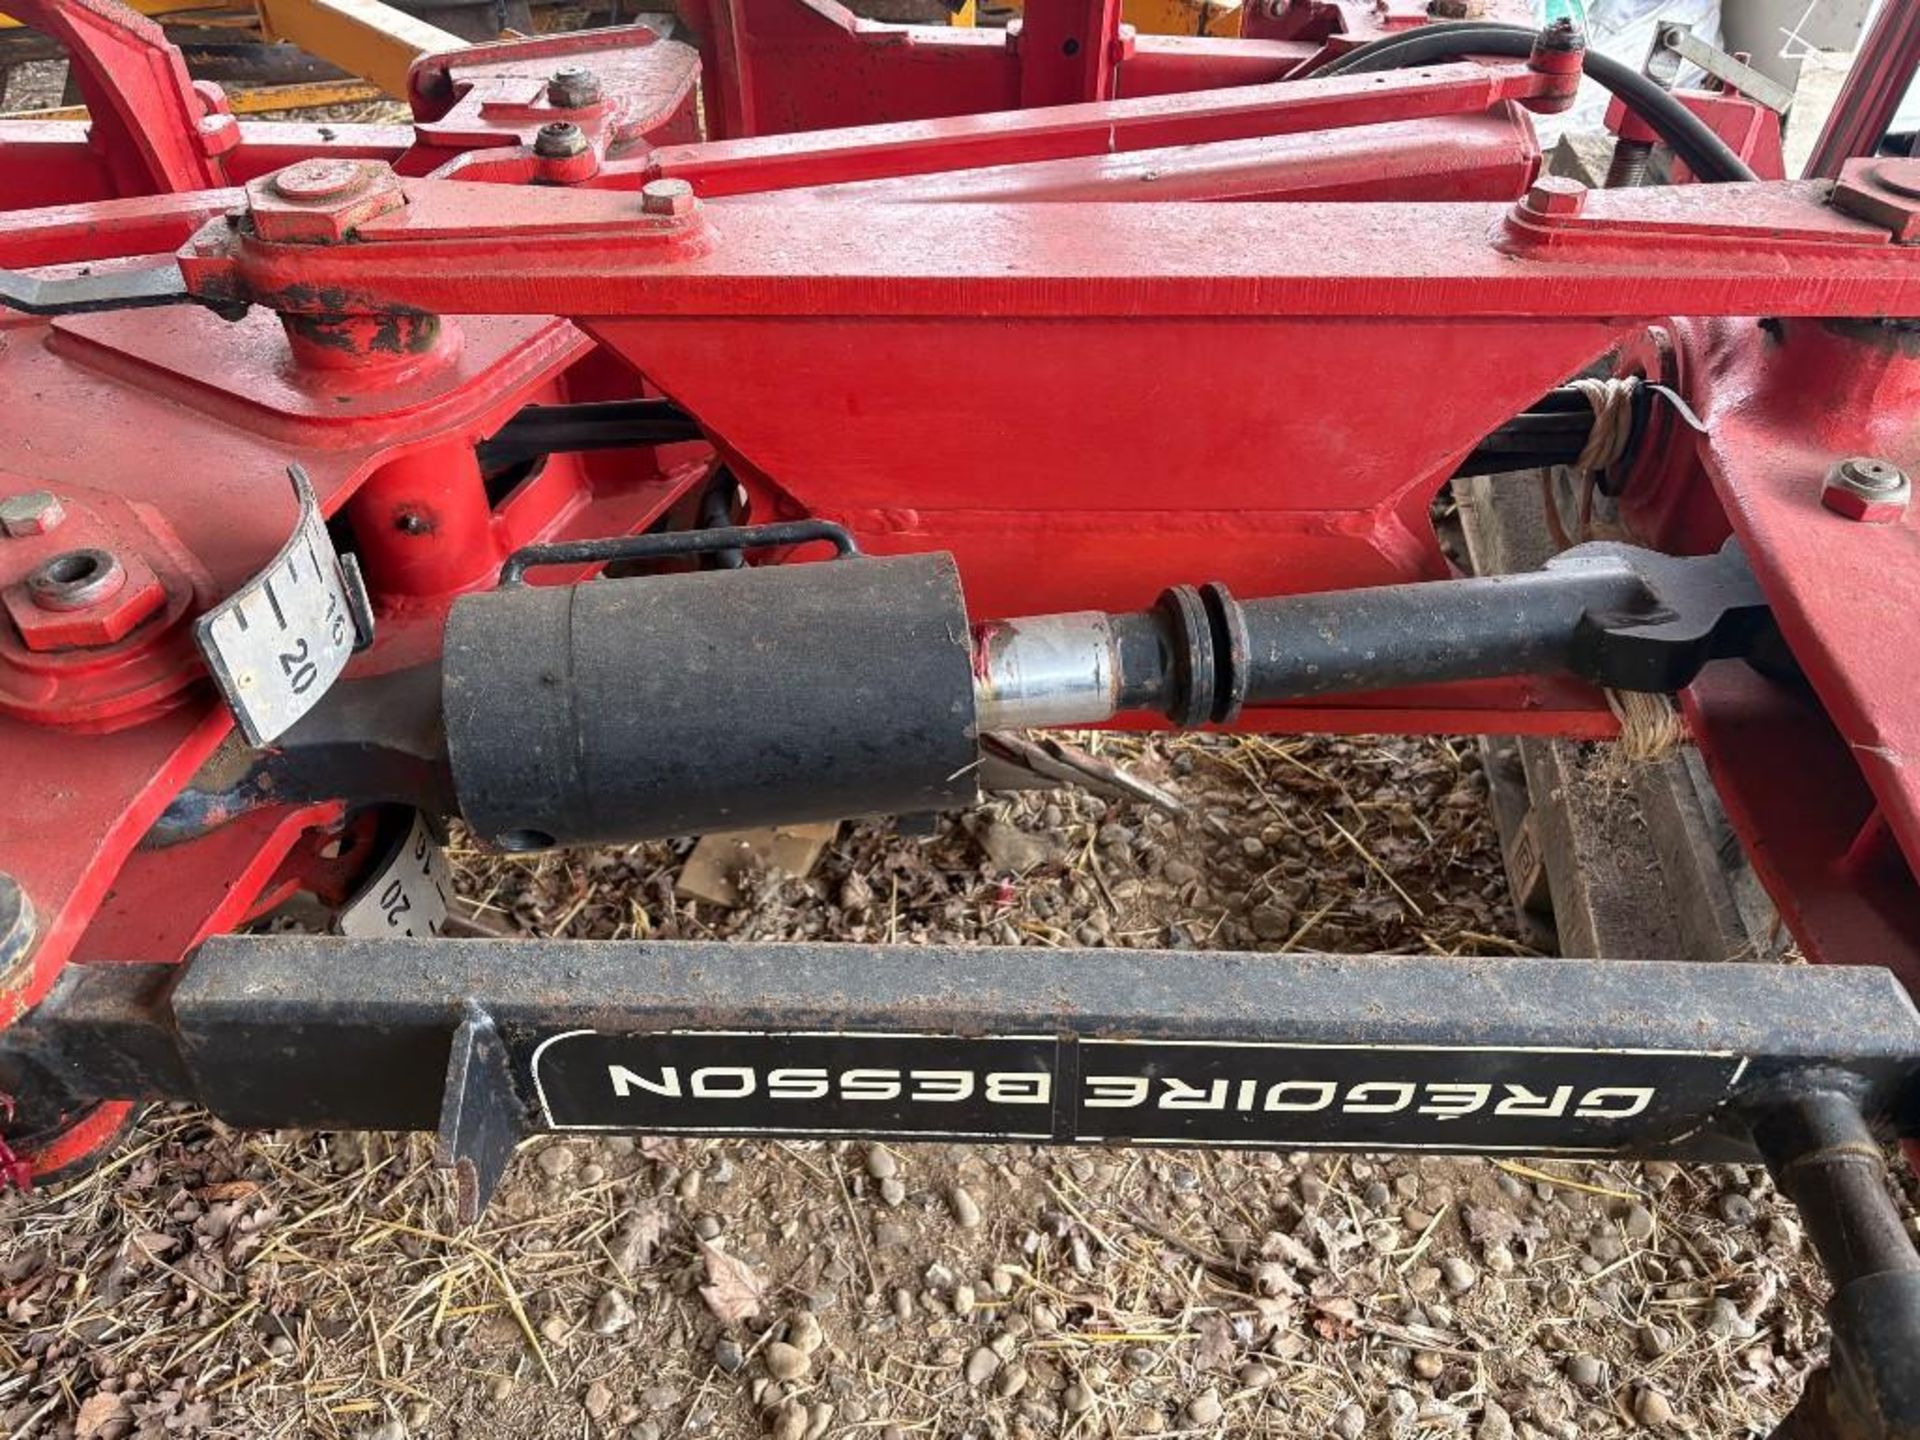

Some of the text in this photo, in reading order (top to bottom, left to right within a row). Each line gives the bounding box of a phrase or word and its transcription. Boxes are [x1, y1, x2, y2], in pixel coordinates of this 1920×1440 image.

[278, 637, 318, 695] 20
[380, 879, 411, 927] 20
[608, 1064, 1655, 1121] GRÉGOIRE BESSON
